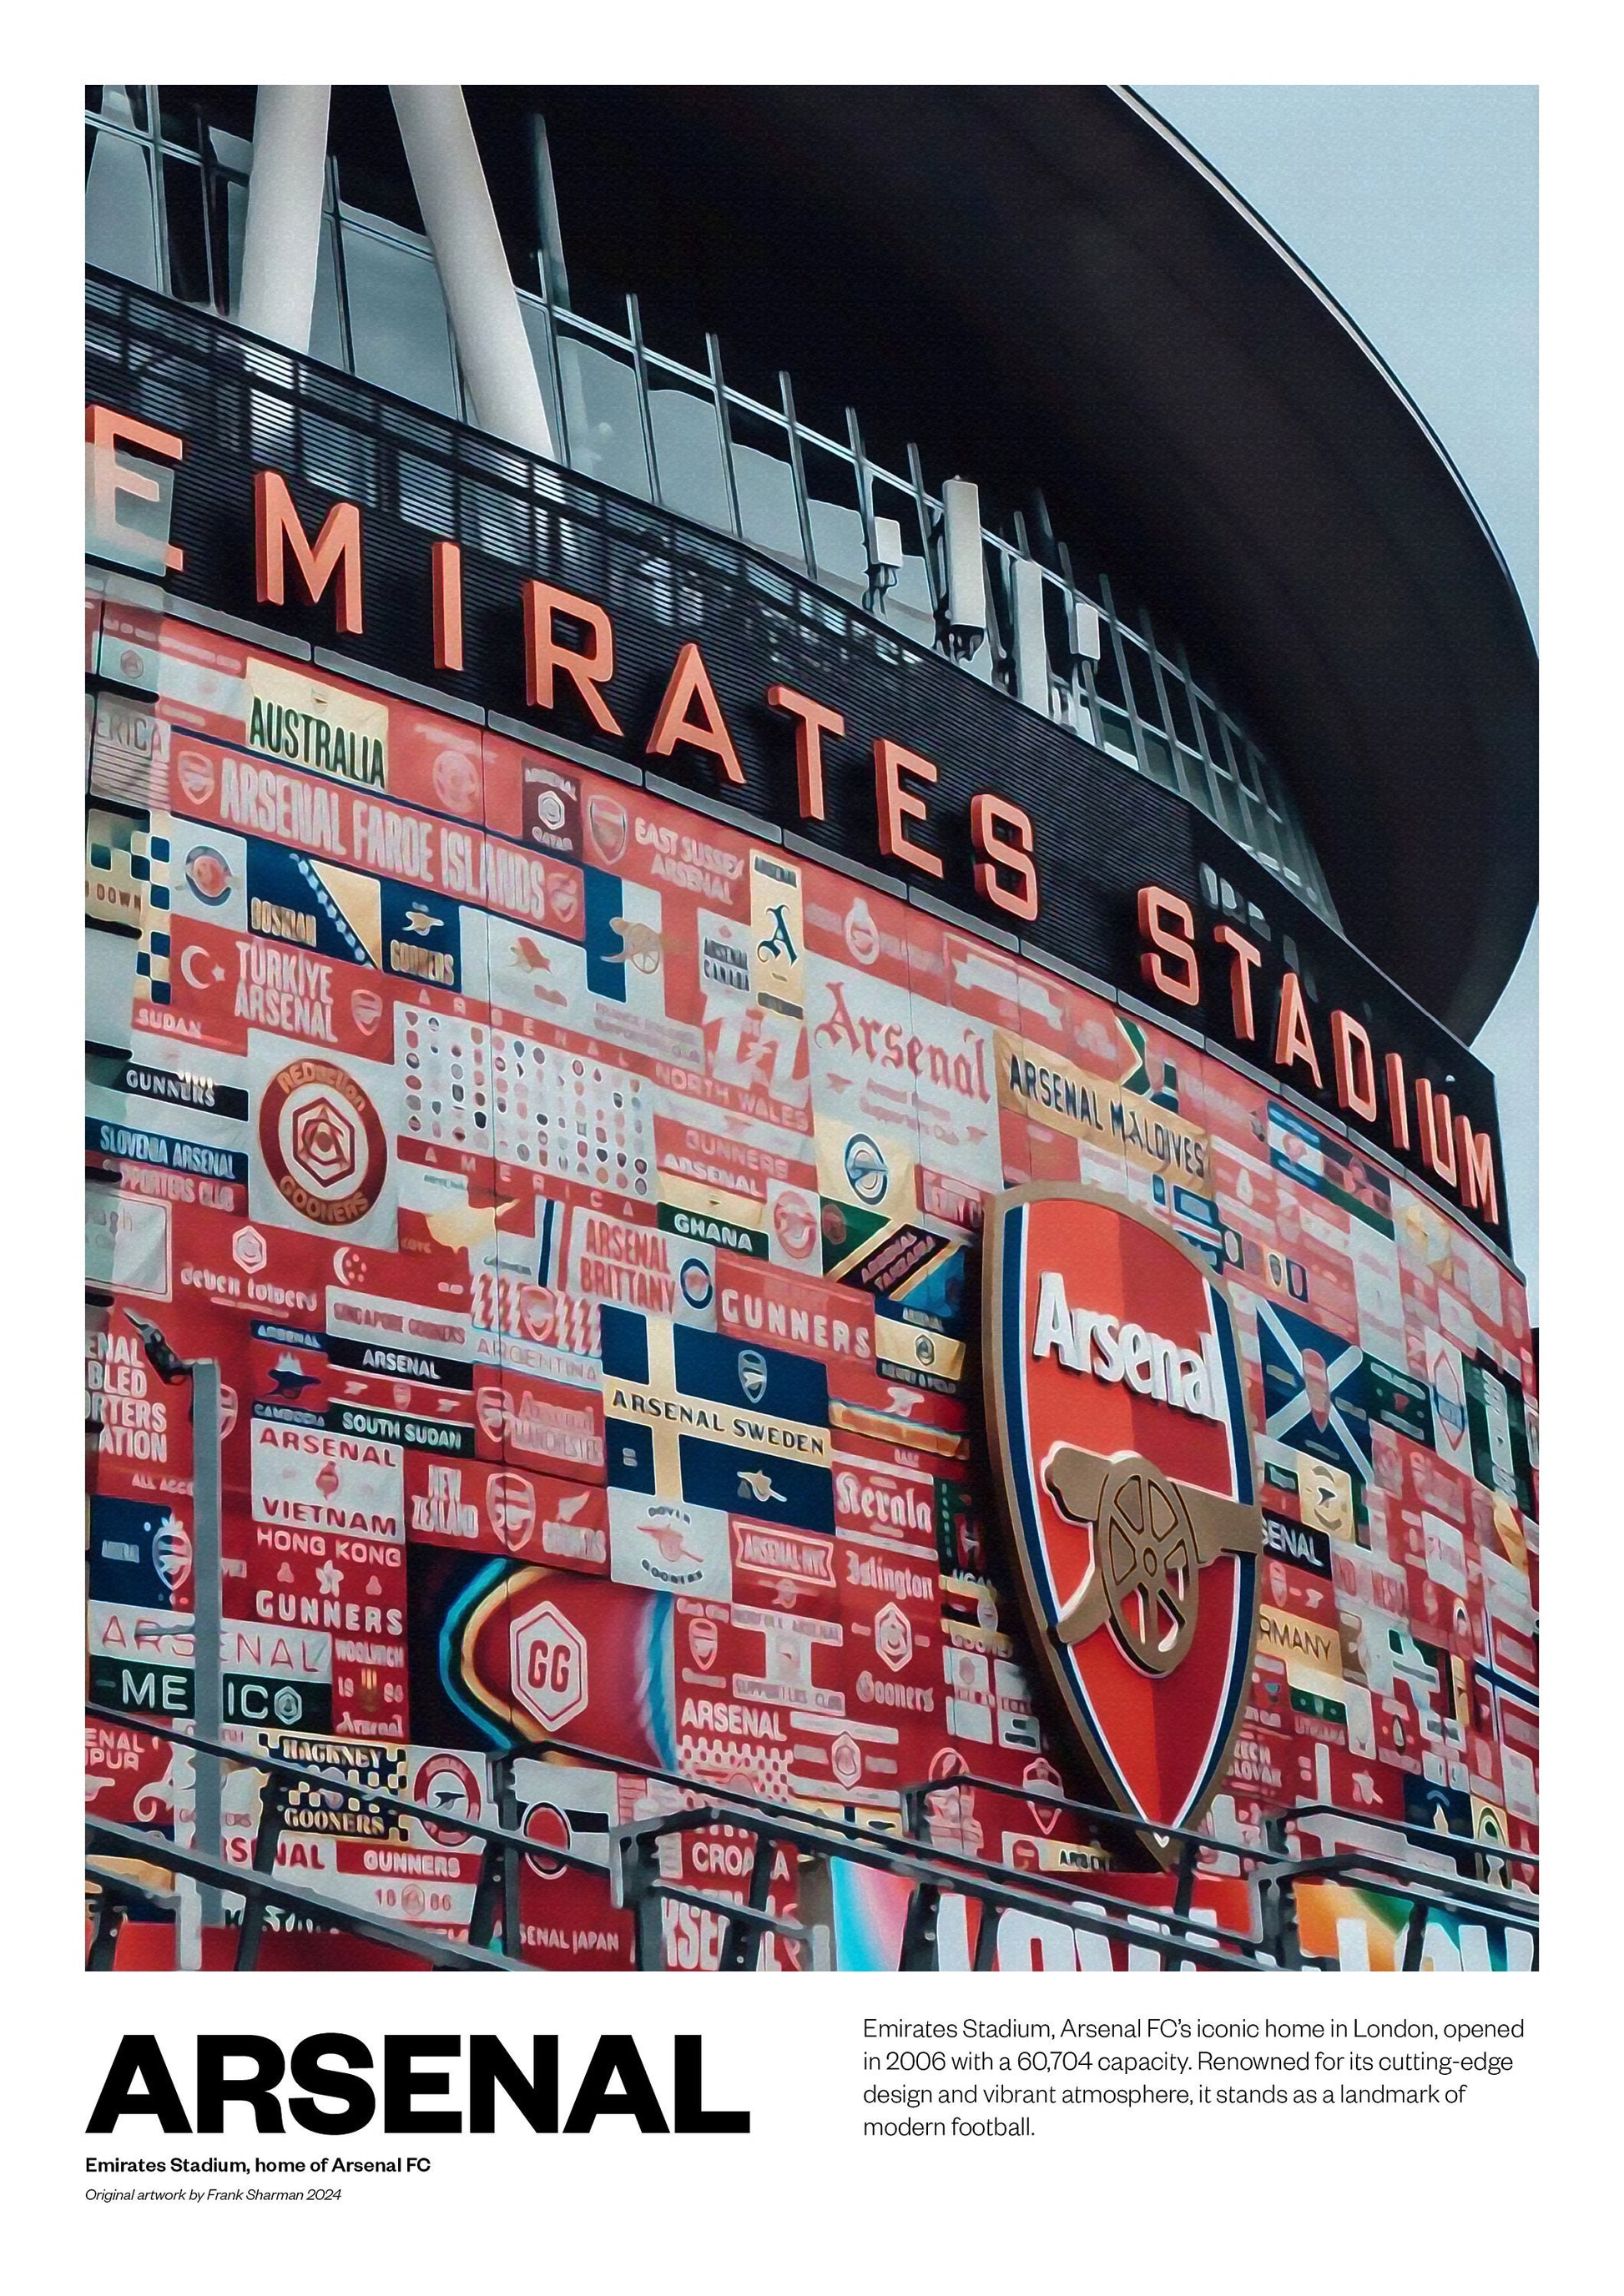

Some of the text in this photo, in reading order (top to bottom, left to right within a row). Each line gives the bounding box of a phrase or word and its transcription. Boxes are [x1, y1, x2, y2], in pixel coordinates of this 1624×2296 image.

[250, 695, 386, 791] AUSTRALIA
[85, 404, 1500, 1226] EMIRATES STADIUM
[219, 756, 346, 856] ARSENAL
[441, 827, 546, 919] ISLANDS
[634, 817, 678, 857] EAST
[138, 1009, 203, 1038] SUDAN
[234, 979, 339, 1043] ARSENAL
[814, 980, 992, 1105] Arsenal
[126, 1069, 216, 1107] GUNNERS
[740, 1092, 809, 1133] WALES
[1009, 1053, 1106, 1132] ARSENAL
[1109, 1100, 1205, 1179] MALDIVES
[173, 1142, 236, 1180] ARSENAL
[424, 1145, 635, 1217] AMERICA
[585, 1218, 672, 1275] ARSENAL
[673, 1212, 754, 1251] GHANA
[579, 1255, 677, 1316] BRITTANY
[720, 1288, 872, 1359] GUNNERS
[362, 1348, 441, 1380] ARSENAL
[476, 1337, 598, 1382] ARGENTINA
[1033, 1271, 1228, 1423] Arsenal
[88, 1359, 148, 1399] BLED
[342, 1411, 461, 1450] SOUTH SUDAN
[613, 1388, 825, 1457] ARSENAL SWEDEN
[259, 1427, 397, 1468] ARSENAL
[261, 1496, 397, 1538] VIETNAM
[835, 1471, 933, 1533] Kerala
[256, 1527, 402, 1568] HONG KONG
[255, 1589, 403, 1636] GUNNERS
[101, 1614, 321, 1674] ARSNAL
[122, 1669, 303, 1725] MEICO
[681, 1697, 789, 1742] ARSENAL
[85, 1747, 139, 1772] PUR
[282, 1738, 383, 1770] HACKNEY
[284, 1807, 386, 1835] GOONERS
[362, 1849, 461, 1879] GUNNERS
[692, 1841, 790, 1882] CROAA
[572, 1929, 619, 1956] JAPAN
